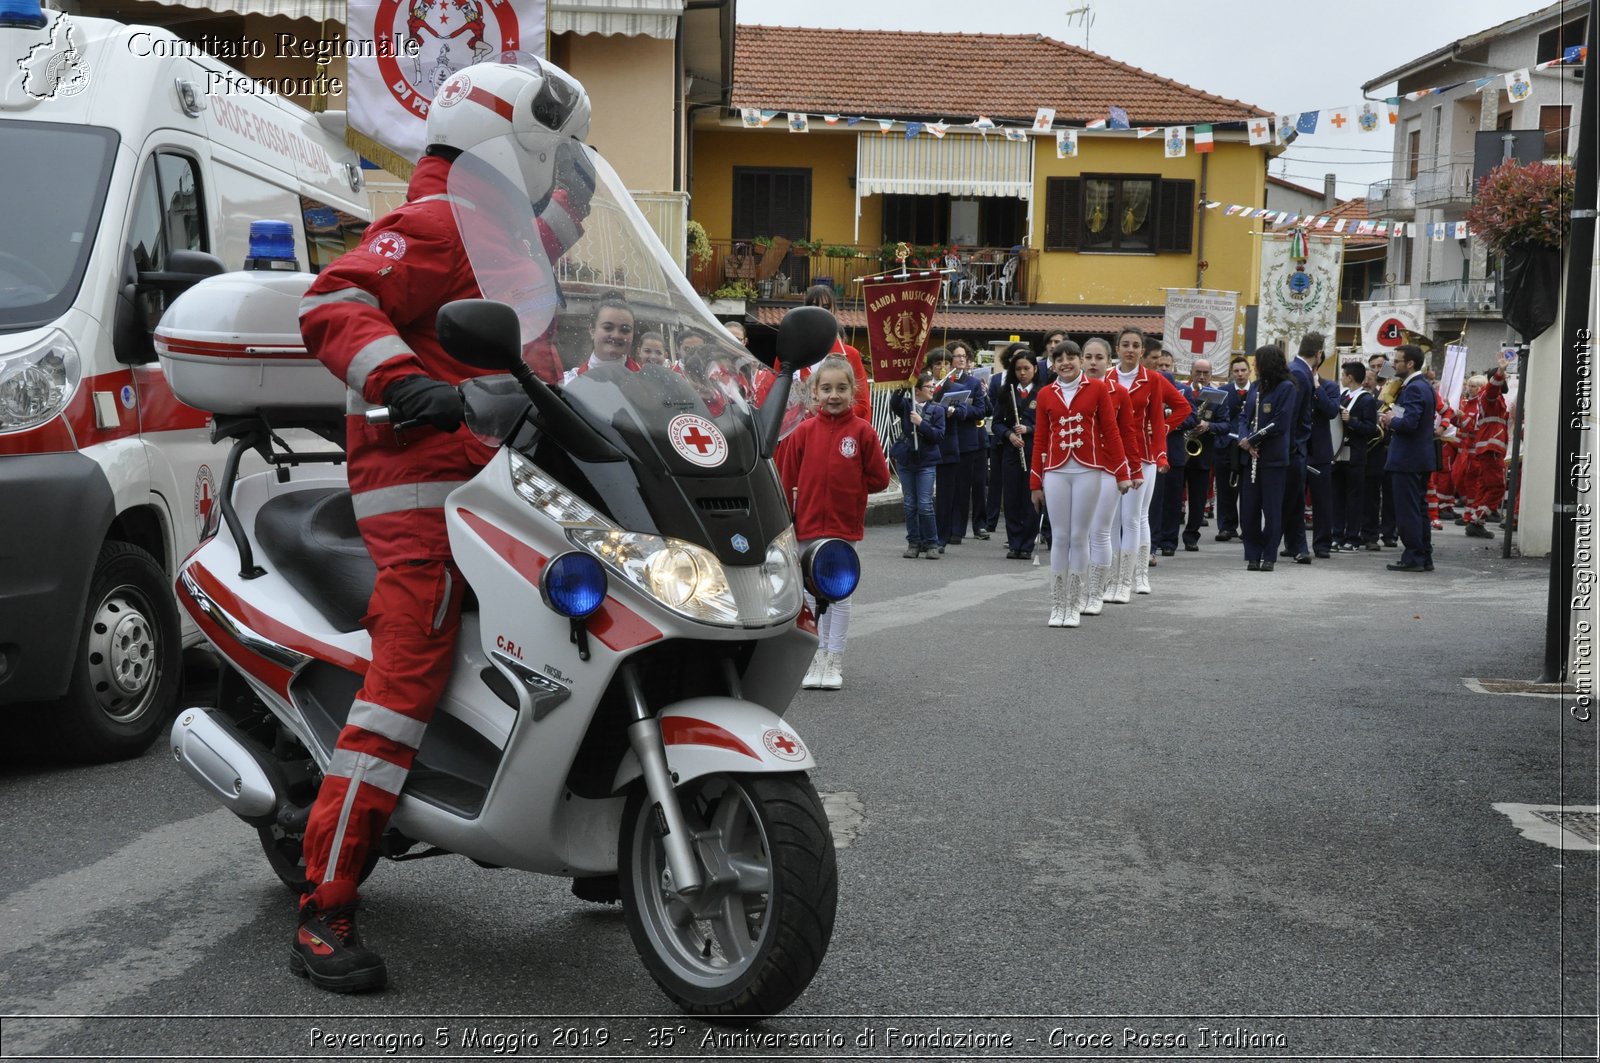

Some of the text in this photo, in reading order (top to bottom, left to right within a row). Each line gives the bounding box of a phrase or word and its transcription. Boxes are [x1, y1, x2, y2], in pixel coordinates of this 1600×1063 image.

[392, 79, 429, 114] DI PE
[210, 95, 333, 177] CROCE ROSSA ITALIANA
[869, 290, 936, 312] BANDA MUSICALE
[880, 358, 914, 368] DI PEVE
[672, 417, 724, 451] CROCE ROSSA ITALIANA
[496, 635, 524, 660] C.R.I.
